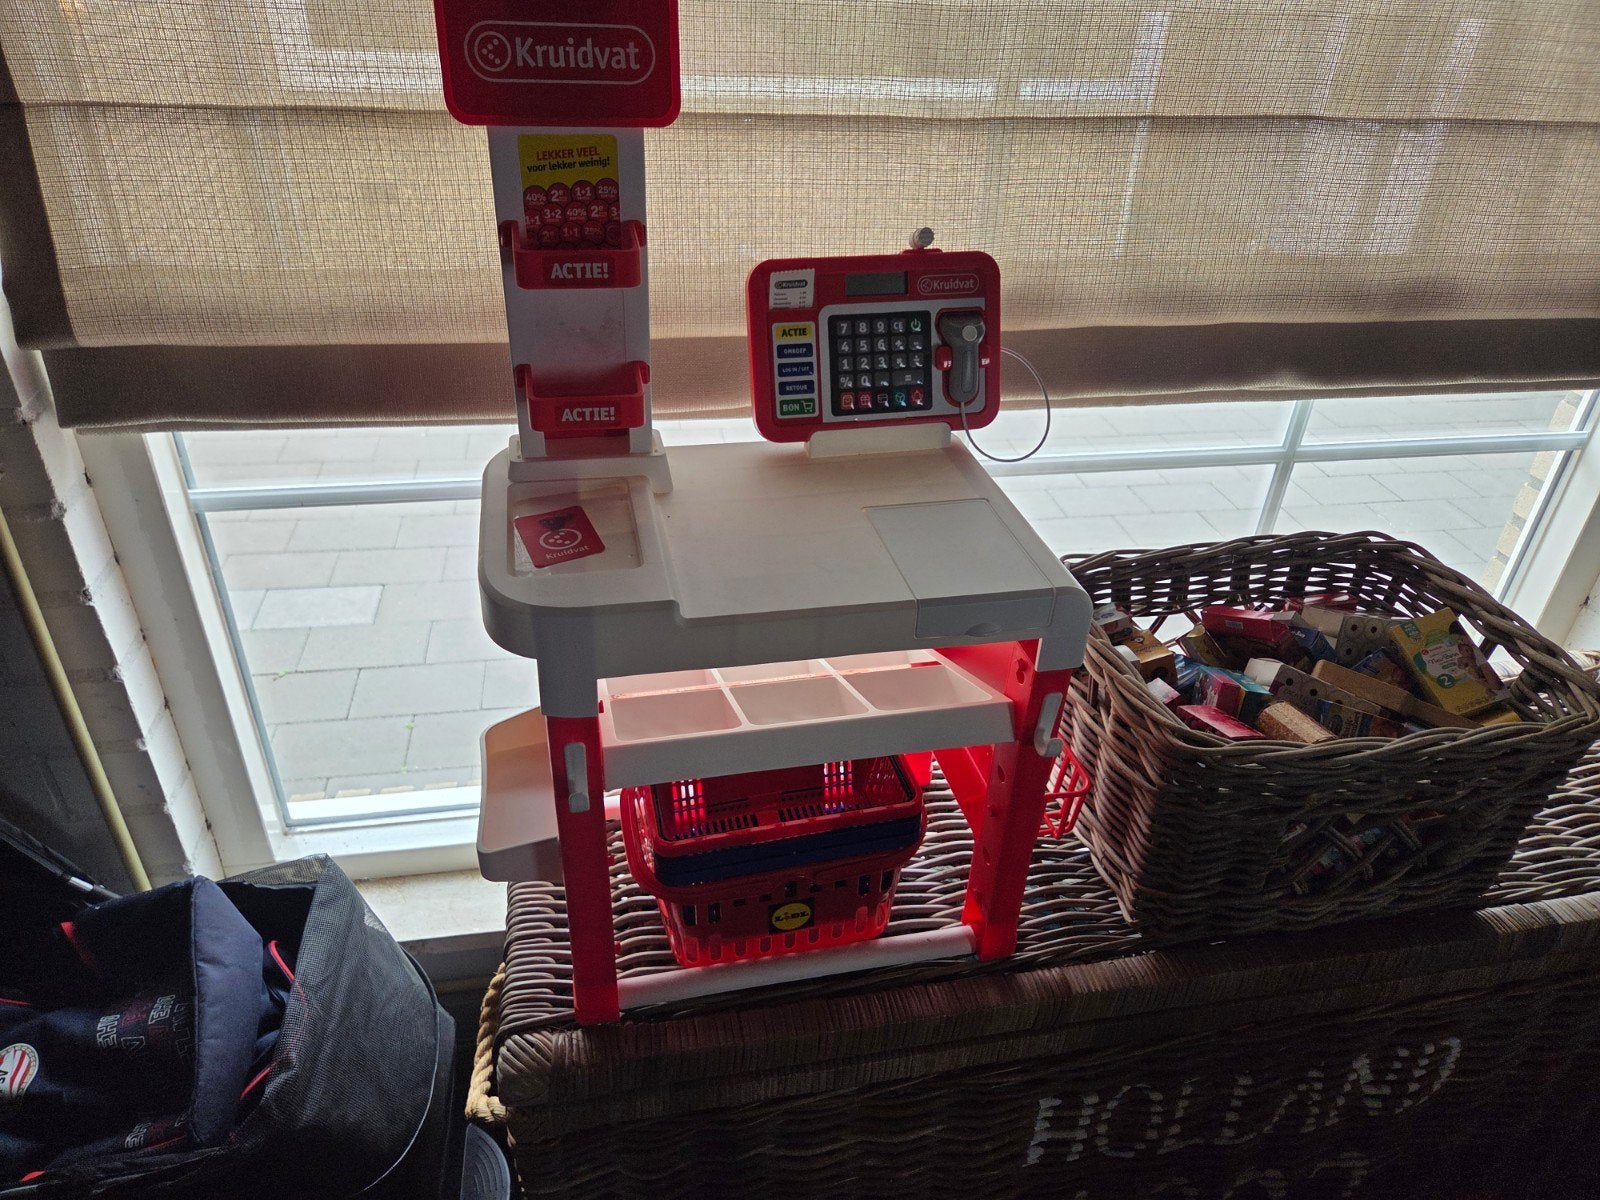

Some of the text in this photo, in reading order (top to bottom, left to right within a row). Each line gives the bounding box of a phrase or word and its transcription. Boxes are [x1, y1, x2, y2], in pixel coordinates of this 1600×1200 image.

[515, 36, 641, 70] Kruidvat
[536, 147, 600, 161] LEKKER VEEL
[527, 156, 610, 173] voor lekker weinig!
[575, 186, 592, 197] 1+1
[544, 208, 562, 219] 3+2
[551, 262, 609, 279] ACTIE!
[932, 279, 975, 291] Kruidvat
[781, 328, 807, 337] ACTIE
[840, 323, 848, 334] 7
[859, 322, 867, 333] 8
[877, 321, 885, 333] 9
[841, 341, 849, 352] 4
[860, 340, 868, 351] 5
[842, 359, 849, 370] 1
[861, 358, 869, 369] 2
[878, 356, 886, 368] 3
[785, 383, 808, 391] RETOUR
[561, 406, 616, 422] ACTIE!
[782, 403, 800, 412] BON
[545, 544, 591, 560] Kruidvat
[1440, 676, 1451, 686] 2
[1022, 1037, 1463, 1167] HOLLAND
